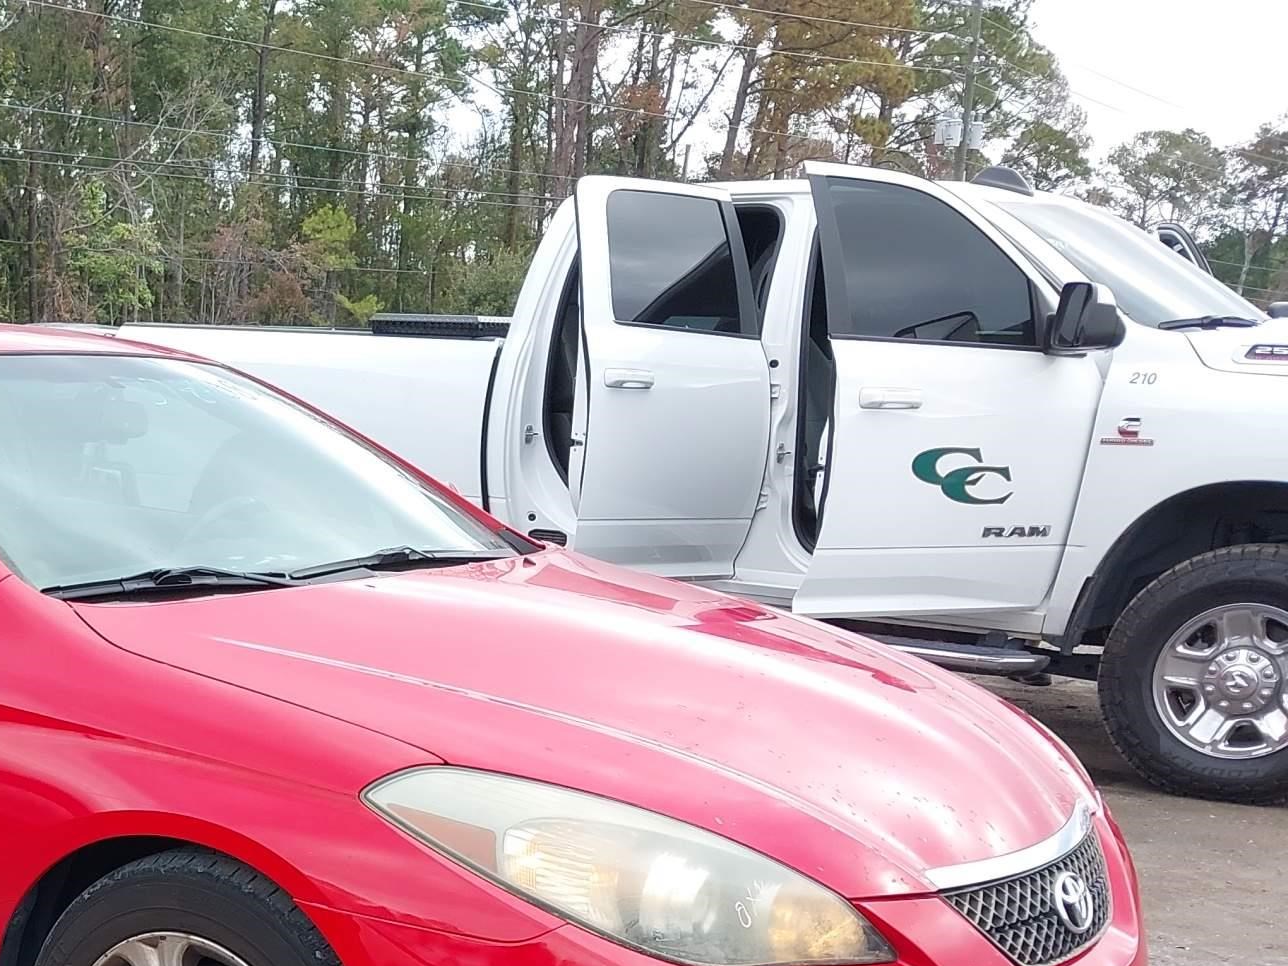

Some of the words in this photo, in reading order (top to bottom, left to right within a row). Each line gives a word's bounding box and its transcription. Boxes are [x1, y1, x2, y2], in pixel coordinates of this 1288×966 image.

[1129, 372, 1157, 385] 210
[912, 447, 1014, 505] CC
[981, 525, 1051, 538] RAM
